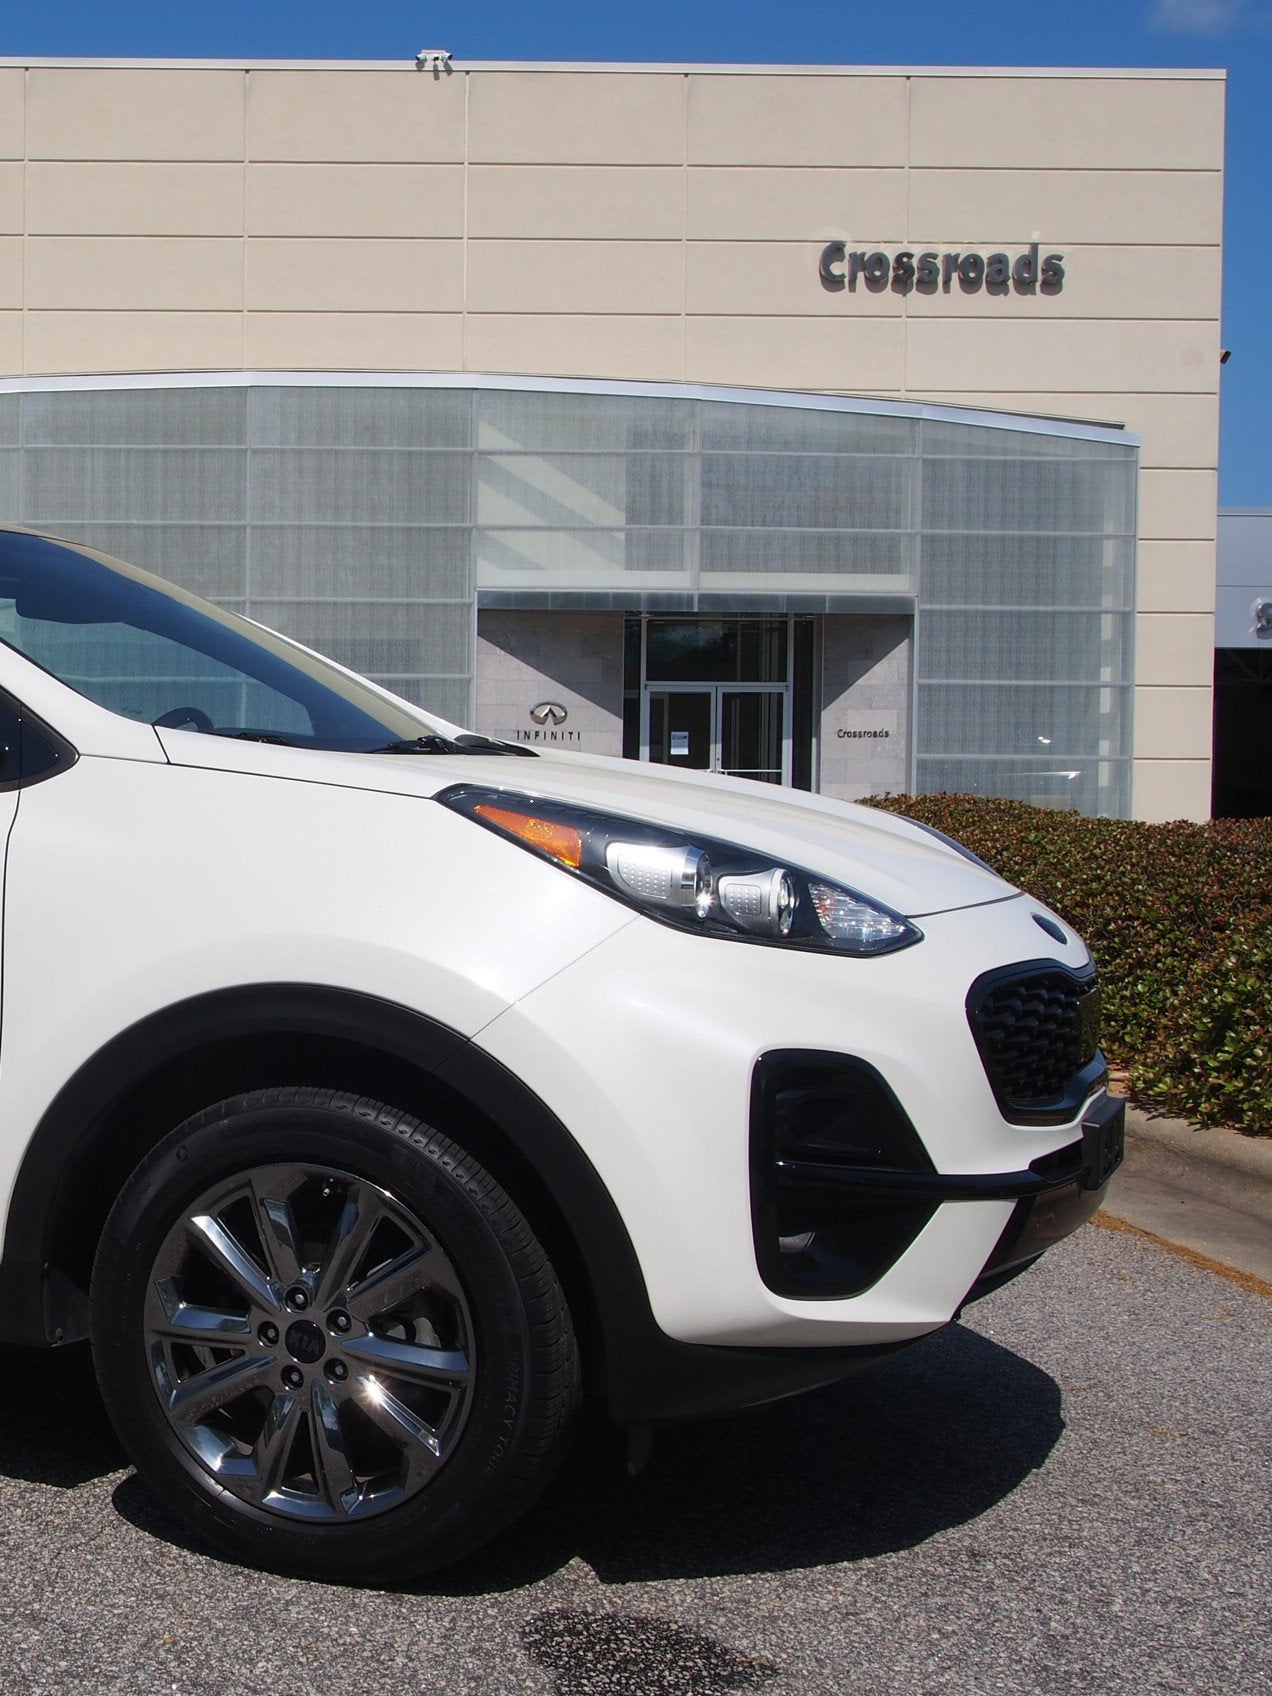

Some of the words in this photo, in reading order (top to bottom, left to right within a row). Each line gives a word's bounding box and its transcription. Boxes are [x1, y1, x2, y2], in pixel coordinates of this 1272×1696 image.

[819, 240, 1066, 284] Crossroads
[516, 730, 581, 741] INFINITI
[837, 728, 890, 739] Crossroads
[288, 1329, 320, 1354] KIA
